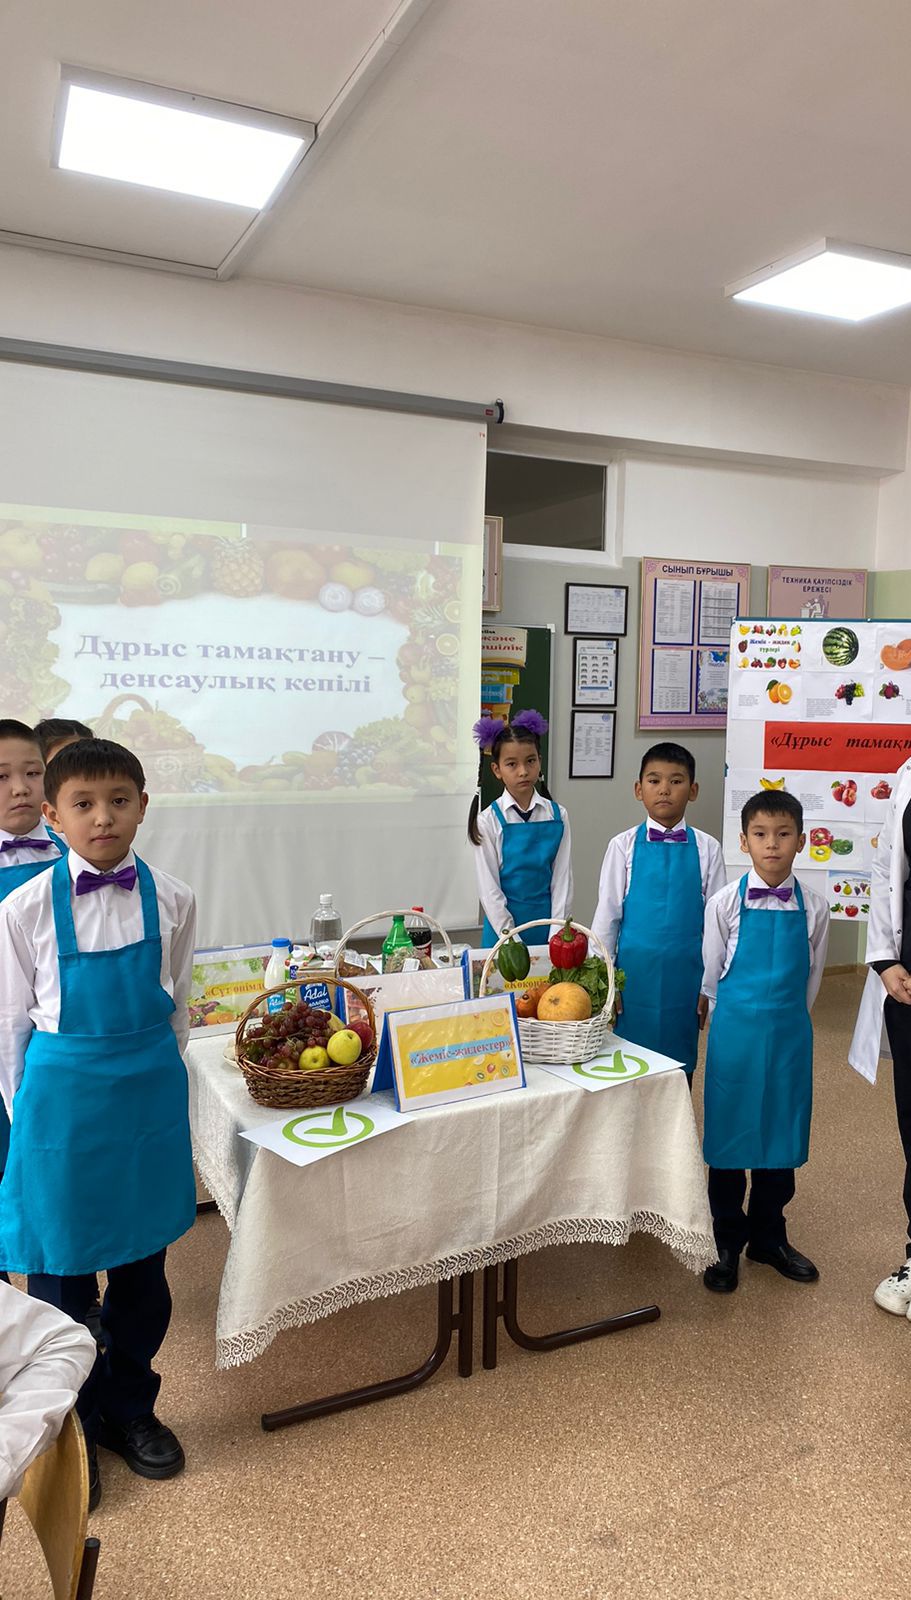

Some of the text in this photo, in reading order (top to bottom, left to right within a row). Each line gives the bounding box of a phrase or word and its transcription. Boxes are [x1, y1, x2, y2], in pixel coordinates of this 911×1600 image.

[662, 565, 733, 576] СЫНЫП БҰРЫШЫ
[74, 634, 187, 660] Дұрыс
[196, 643, 361, 668] тамақтану
[100, 670, 372, 693] денсаулық кепілі
[770, 732, 832, 749] «Дұрыс
[304, 986, 328, 1001] Adal
[410, 1039, 511, 1065] «Жеміс-жидектер»
